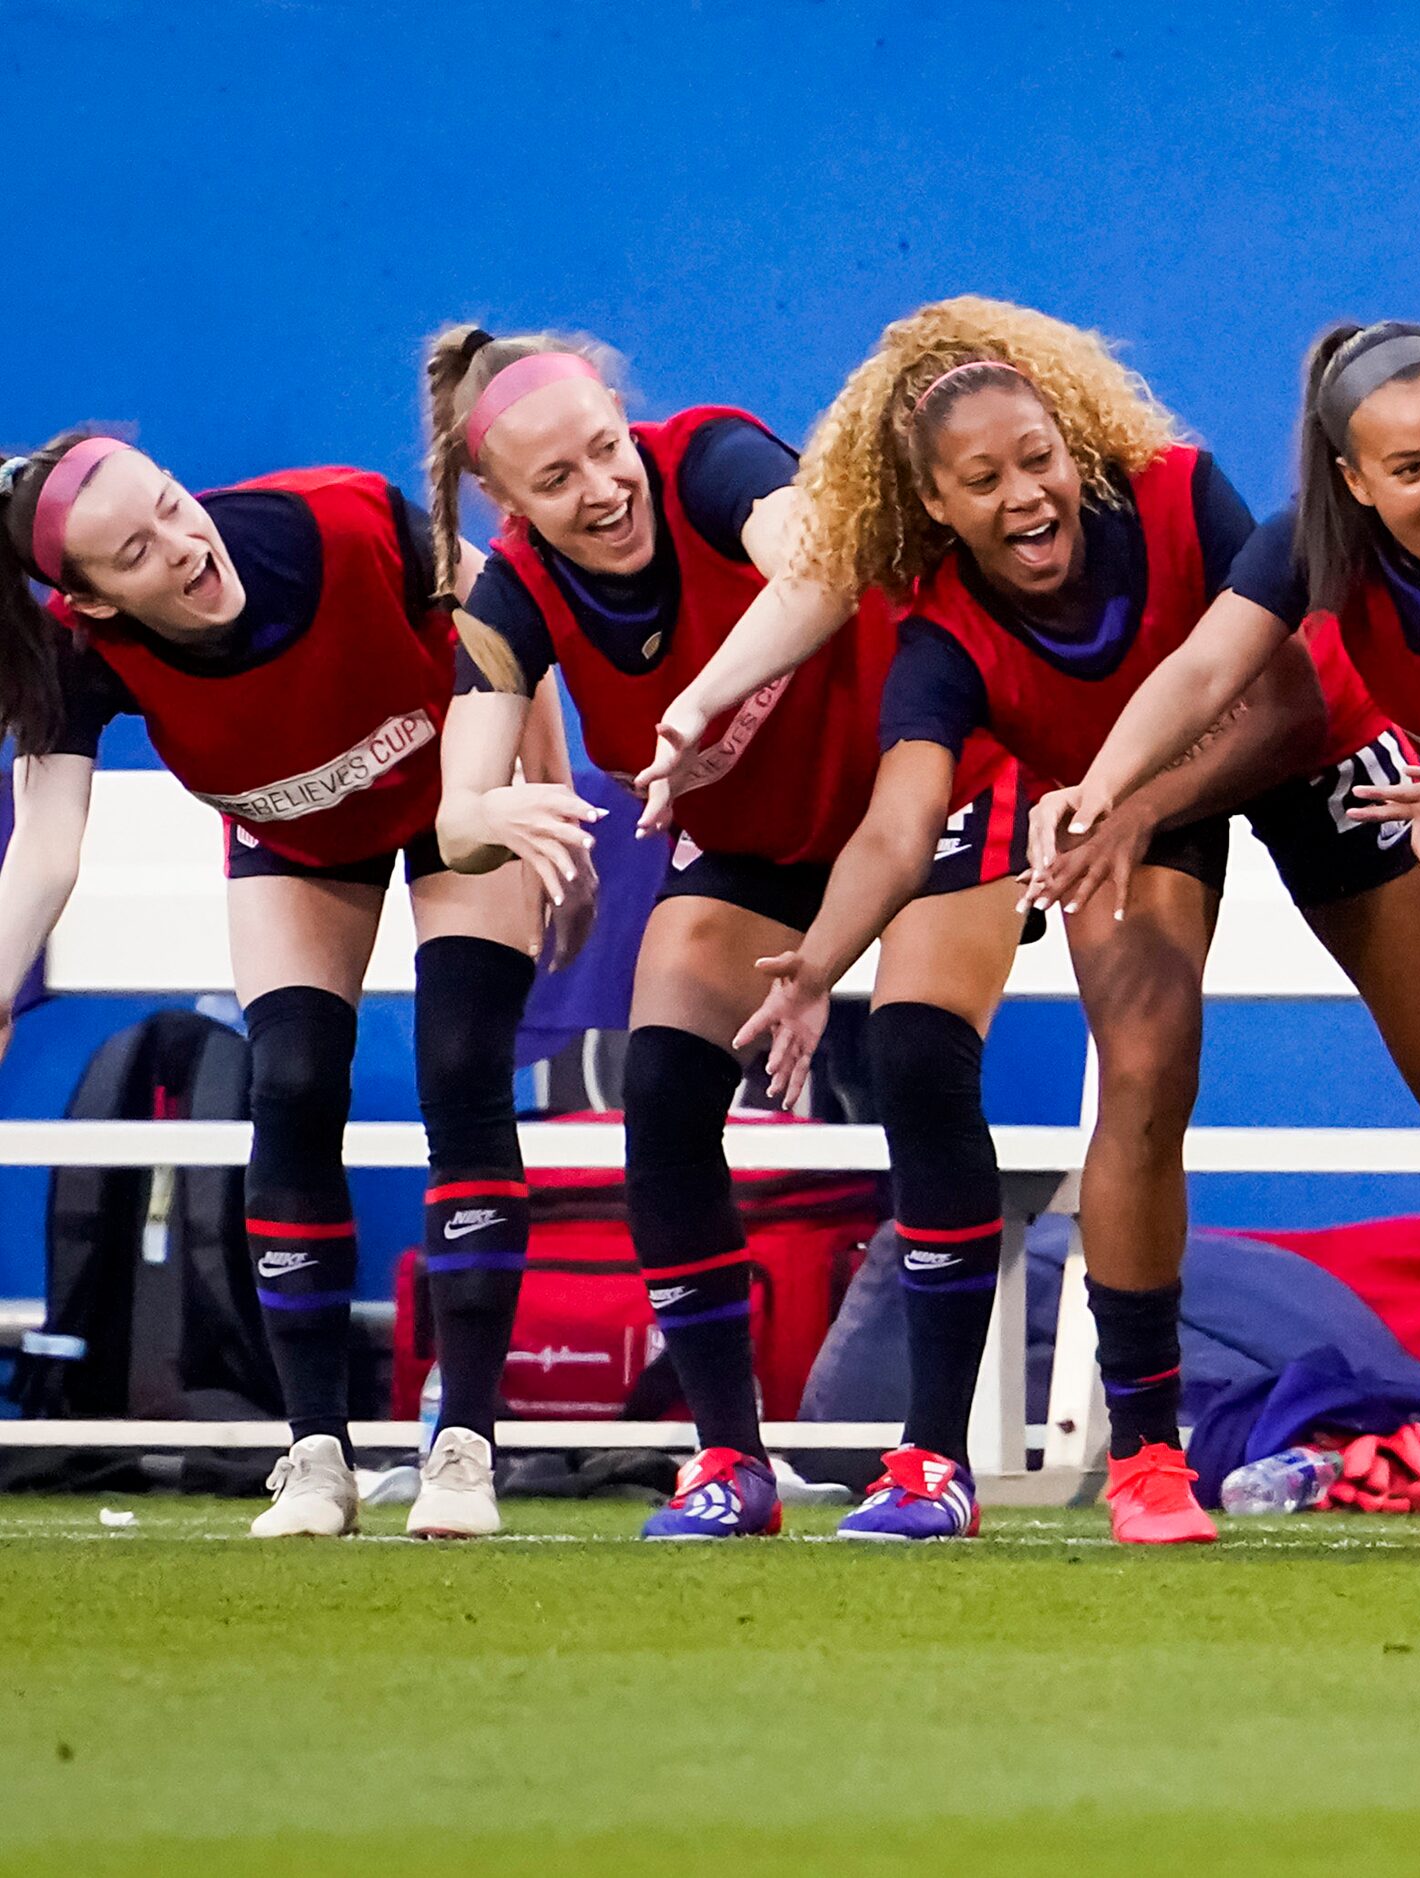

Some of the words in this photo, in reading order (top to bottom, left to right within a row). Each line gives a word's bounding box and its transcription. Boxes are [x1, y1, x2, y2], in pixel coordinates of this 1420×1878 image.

[370, 716, 418, 764] CUP
[451, 1209, 497, 1225] NIKE
[264, 1251, 308, 1267] NIKE
